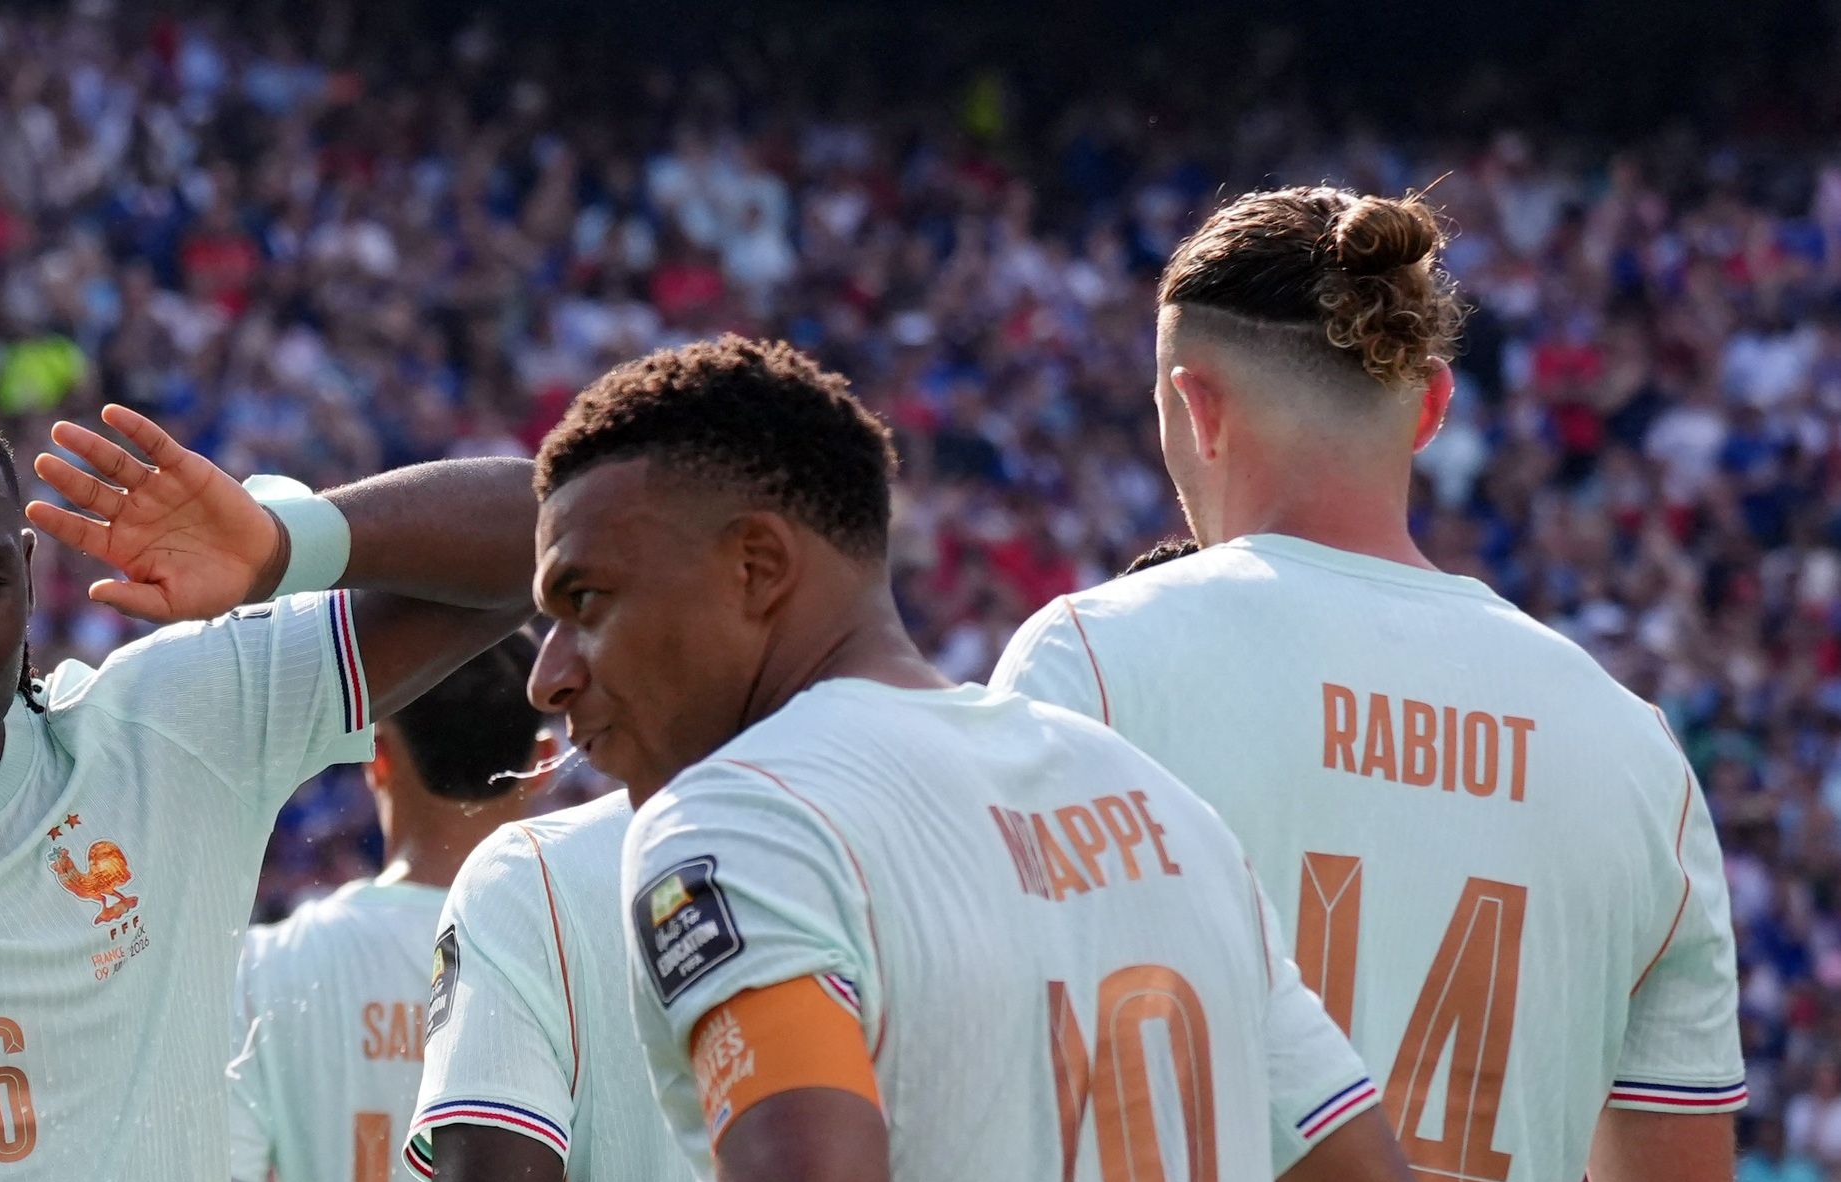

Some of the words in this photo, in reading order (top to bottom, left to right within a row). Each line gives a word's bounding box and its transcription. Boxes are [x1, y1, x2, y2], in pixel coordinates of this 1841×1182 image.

[1322, 682, 1536, 802] RABIOT
[989, 791, 1182, 901] APPE
[91, 946, 126, 967] FRANCE
[362, 1000, 425, 1062] SAL
